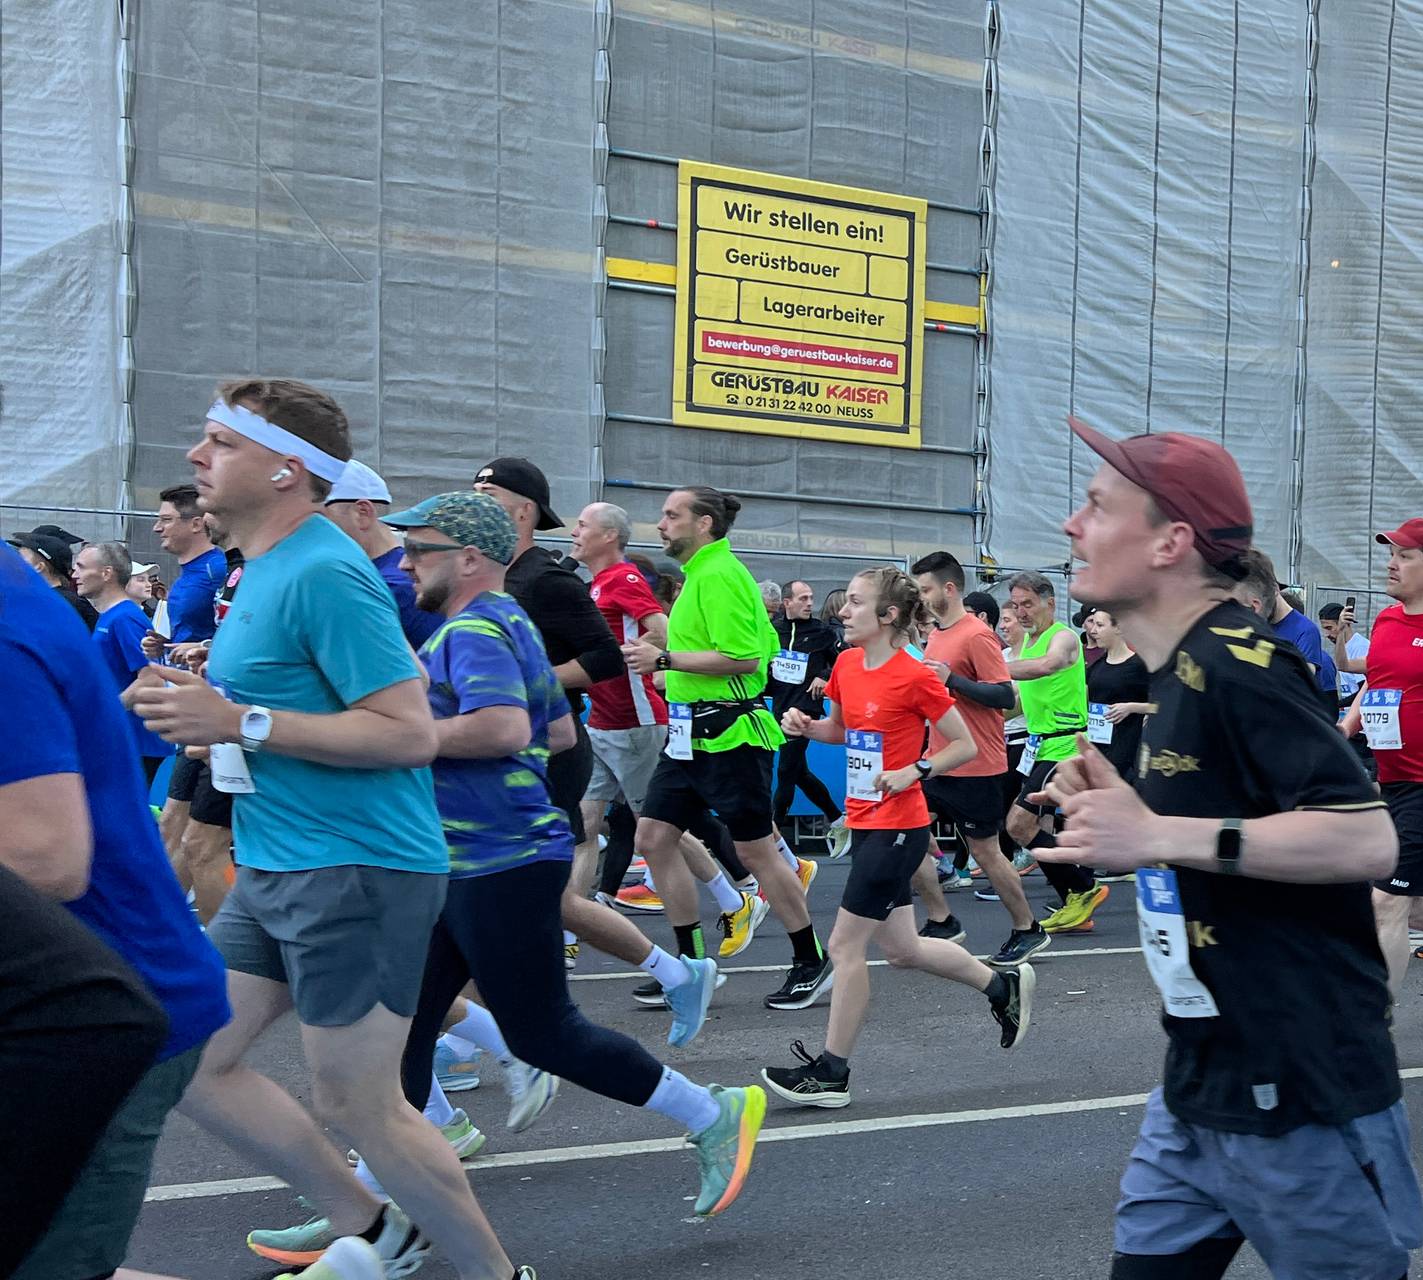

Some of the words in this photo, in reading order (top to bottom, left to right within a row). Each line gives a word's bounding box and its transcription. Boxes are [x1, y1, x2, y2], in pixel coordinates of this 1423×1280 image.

[724, 201, 762, 224] Wir
[769, 209, 839, 236] stellen
[845, 220, 884, 243] ein!
[725, 248, 840, 277] Gerüstbauer
[764, 296, 885, 327] Lagerarbeiter
[708, 336, 893, 369] bewerbung@geruestbau-kaiser.de
[745, 396, 754, 406] 0
[756, 397, 767, 407] 21
[768, 398, 780, 409] 31
[783, 400, 796, 411] 22
[799, 402, 813, 412] 42
[815, 403, 831, 415] 00
[837, 406, 873, 418] NEUSS
[826, 384, 889, 405] KAISER
[1363, 712, 1389, 724] 10179
